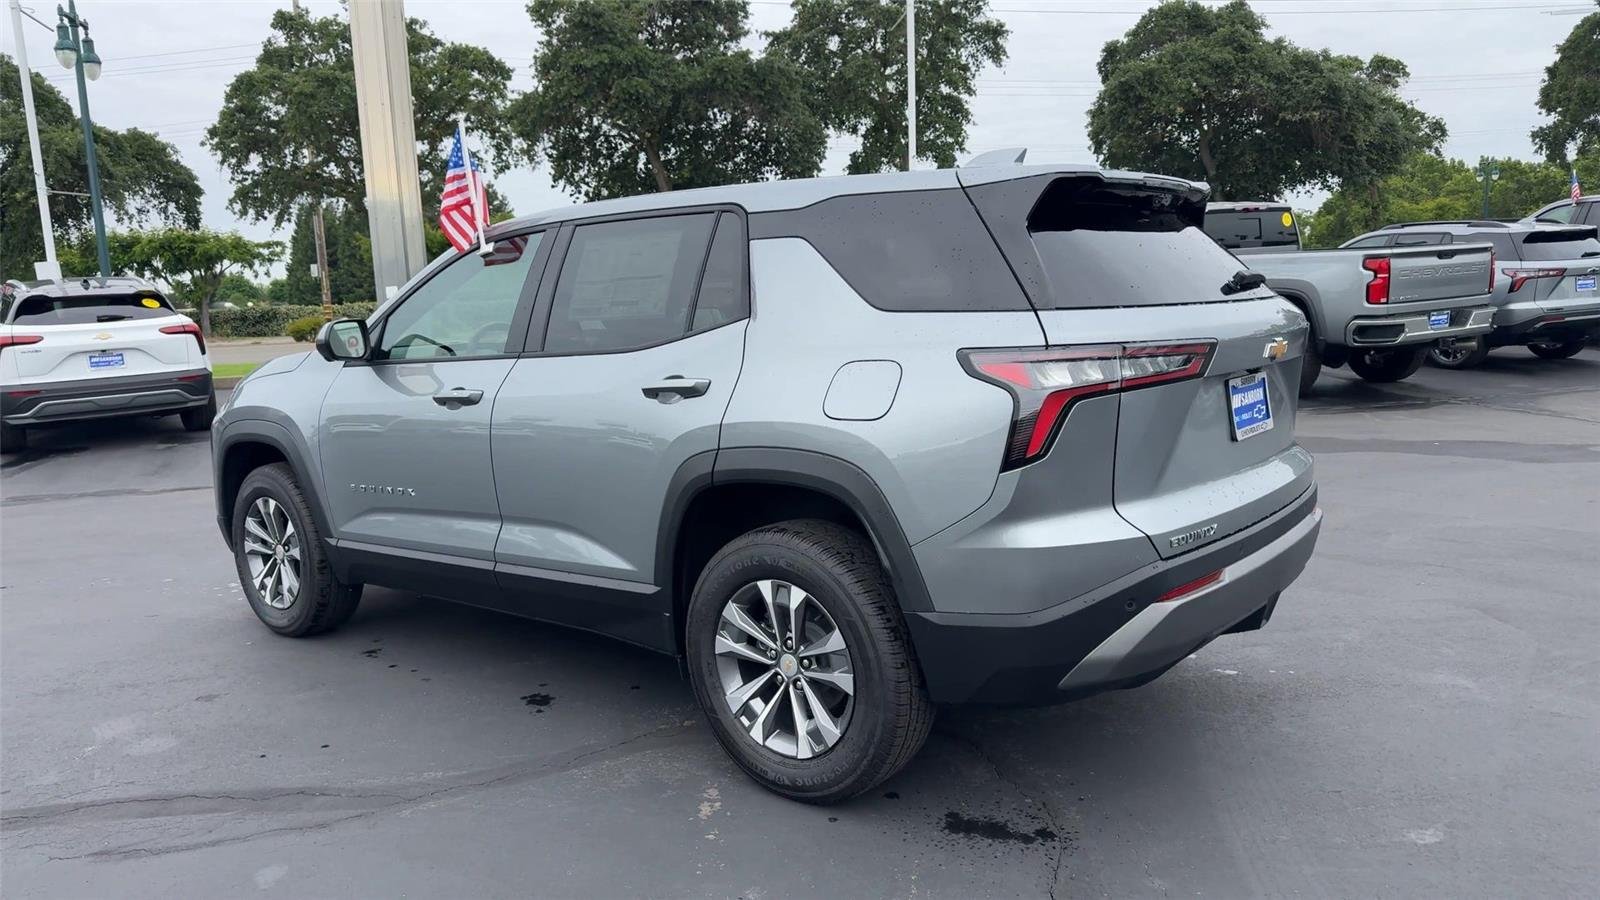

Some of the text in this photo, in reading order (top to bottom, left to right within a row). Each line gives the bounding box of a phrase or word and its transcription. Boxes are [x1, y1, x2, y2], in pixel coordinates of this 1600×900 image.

[1399, 263, 1486, 279] CHEVROLET
[349, 483, 416, 496] EQUINOX
[1168, 523, 1218, 548] EQUINOX
